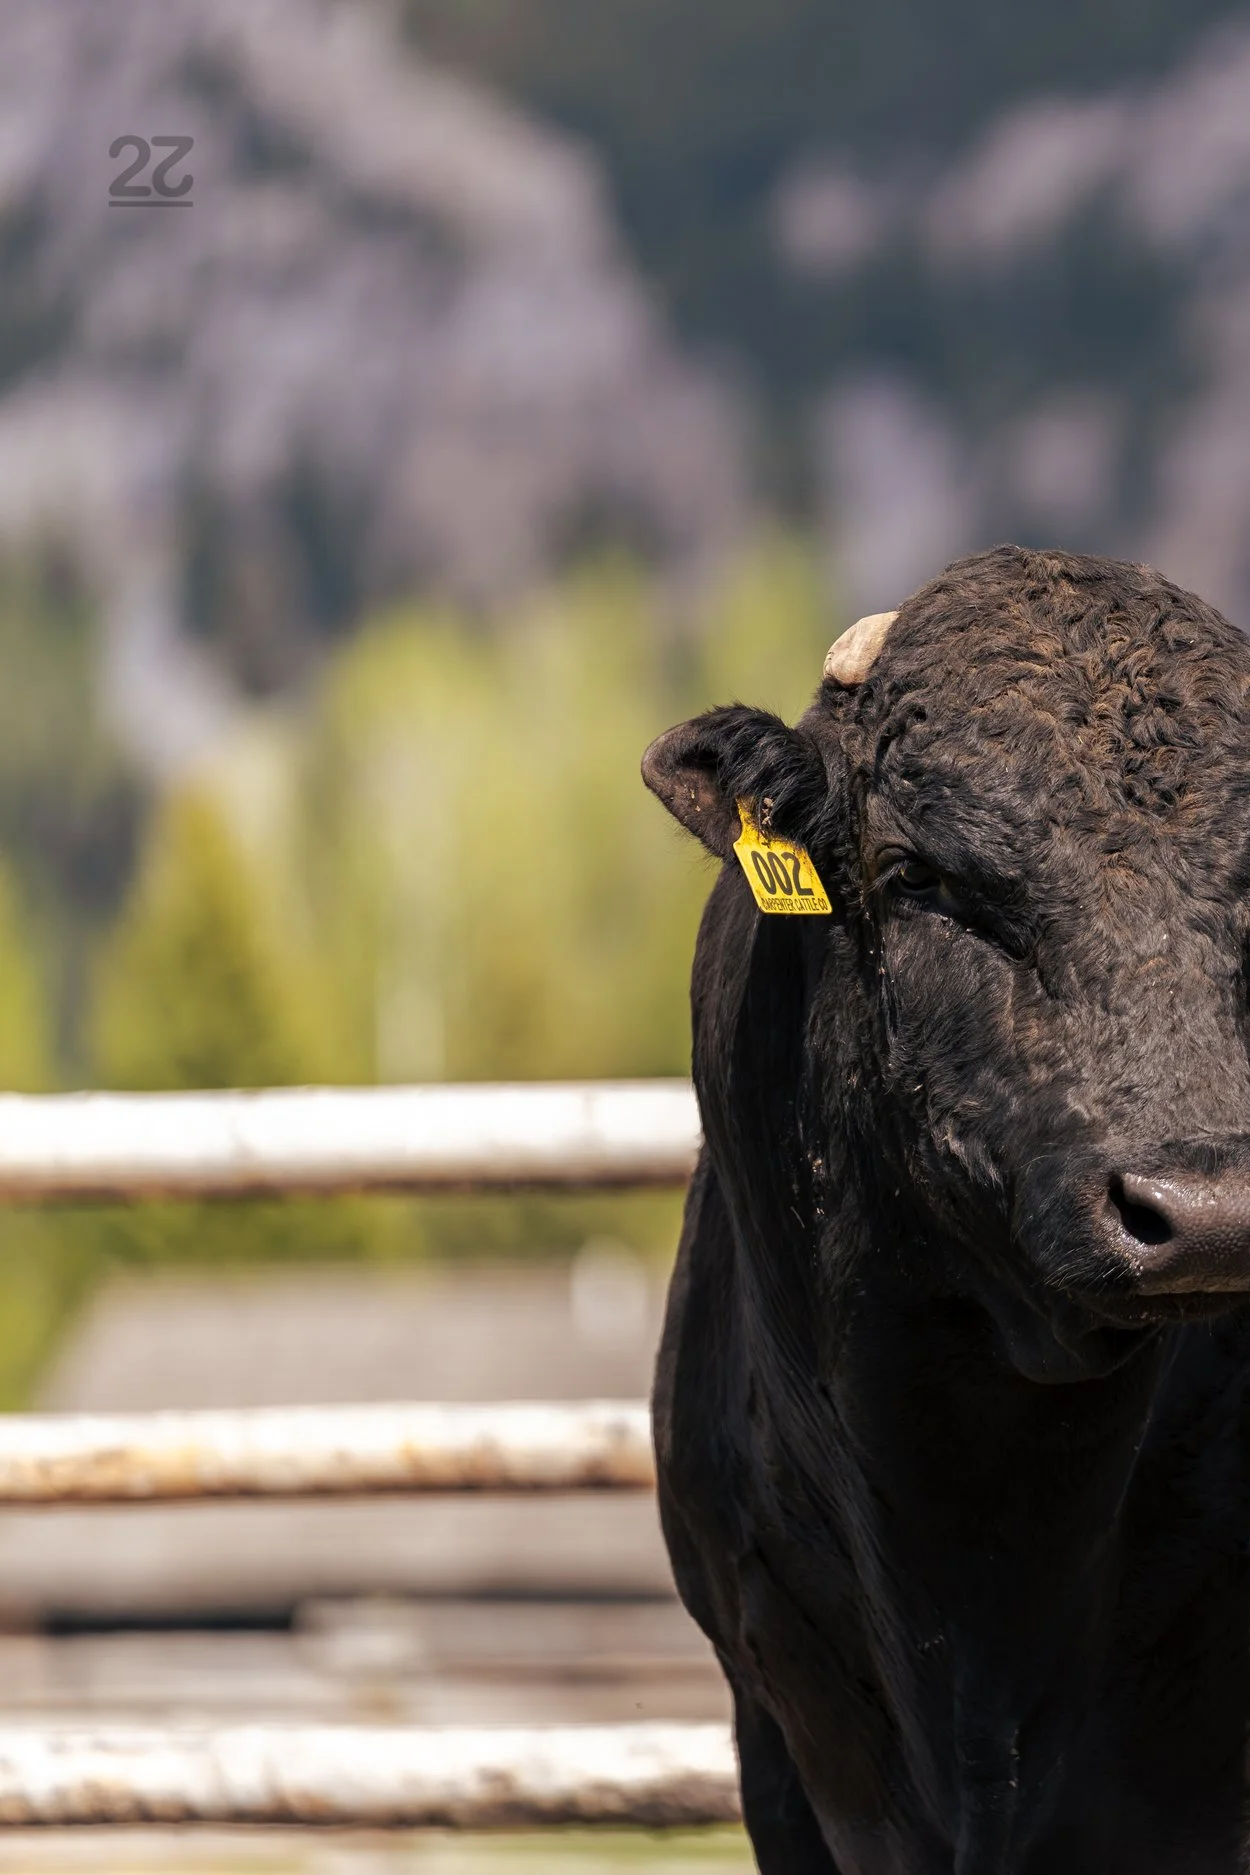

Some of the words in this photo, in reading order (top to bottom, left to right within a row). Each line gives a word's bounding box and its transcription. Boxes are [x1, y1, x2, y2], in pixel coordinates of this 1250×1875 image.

[751, 851, 814, 896] 002
[761, 898, 795, 911] CARPENTER
[794, 898, 819, 911] CATTLE
